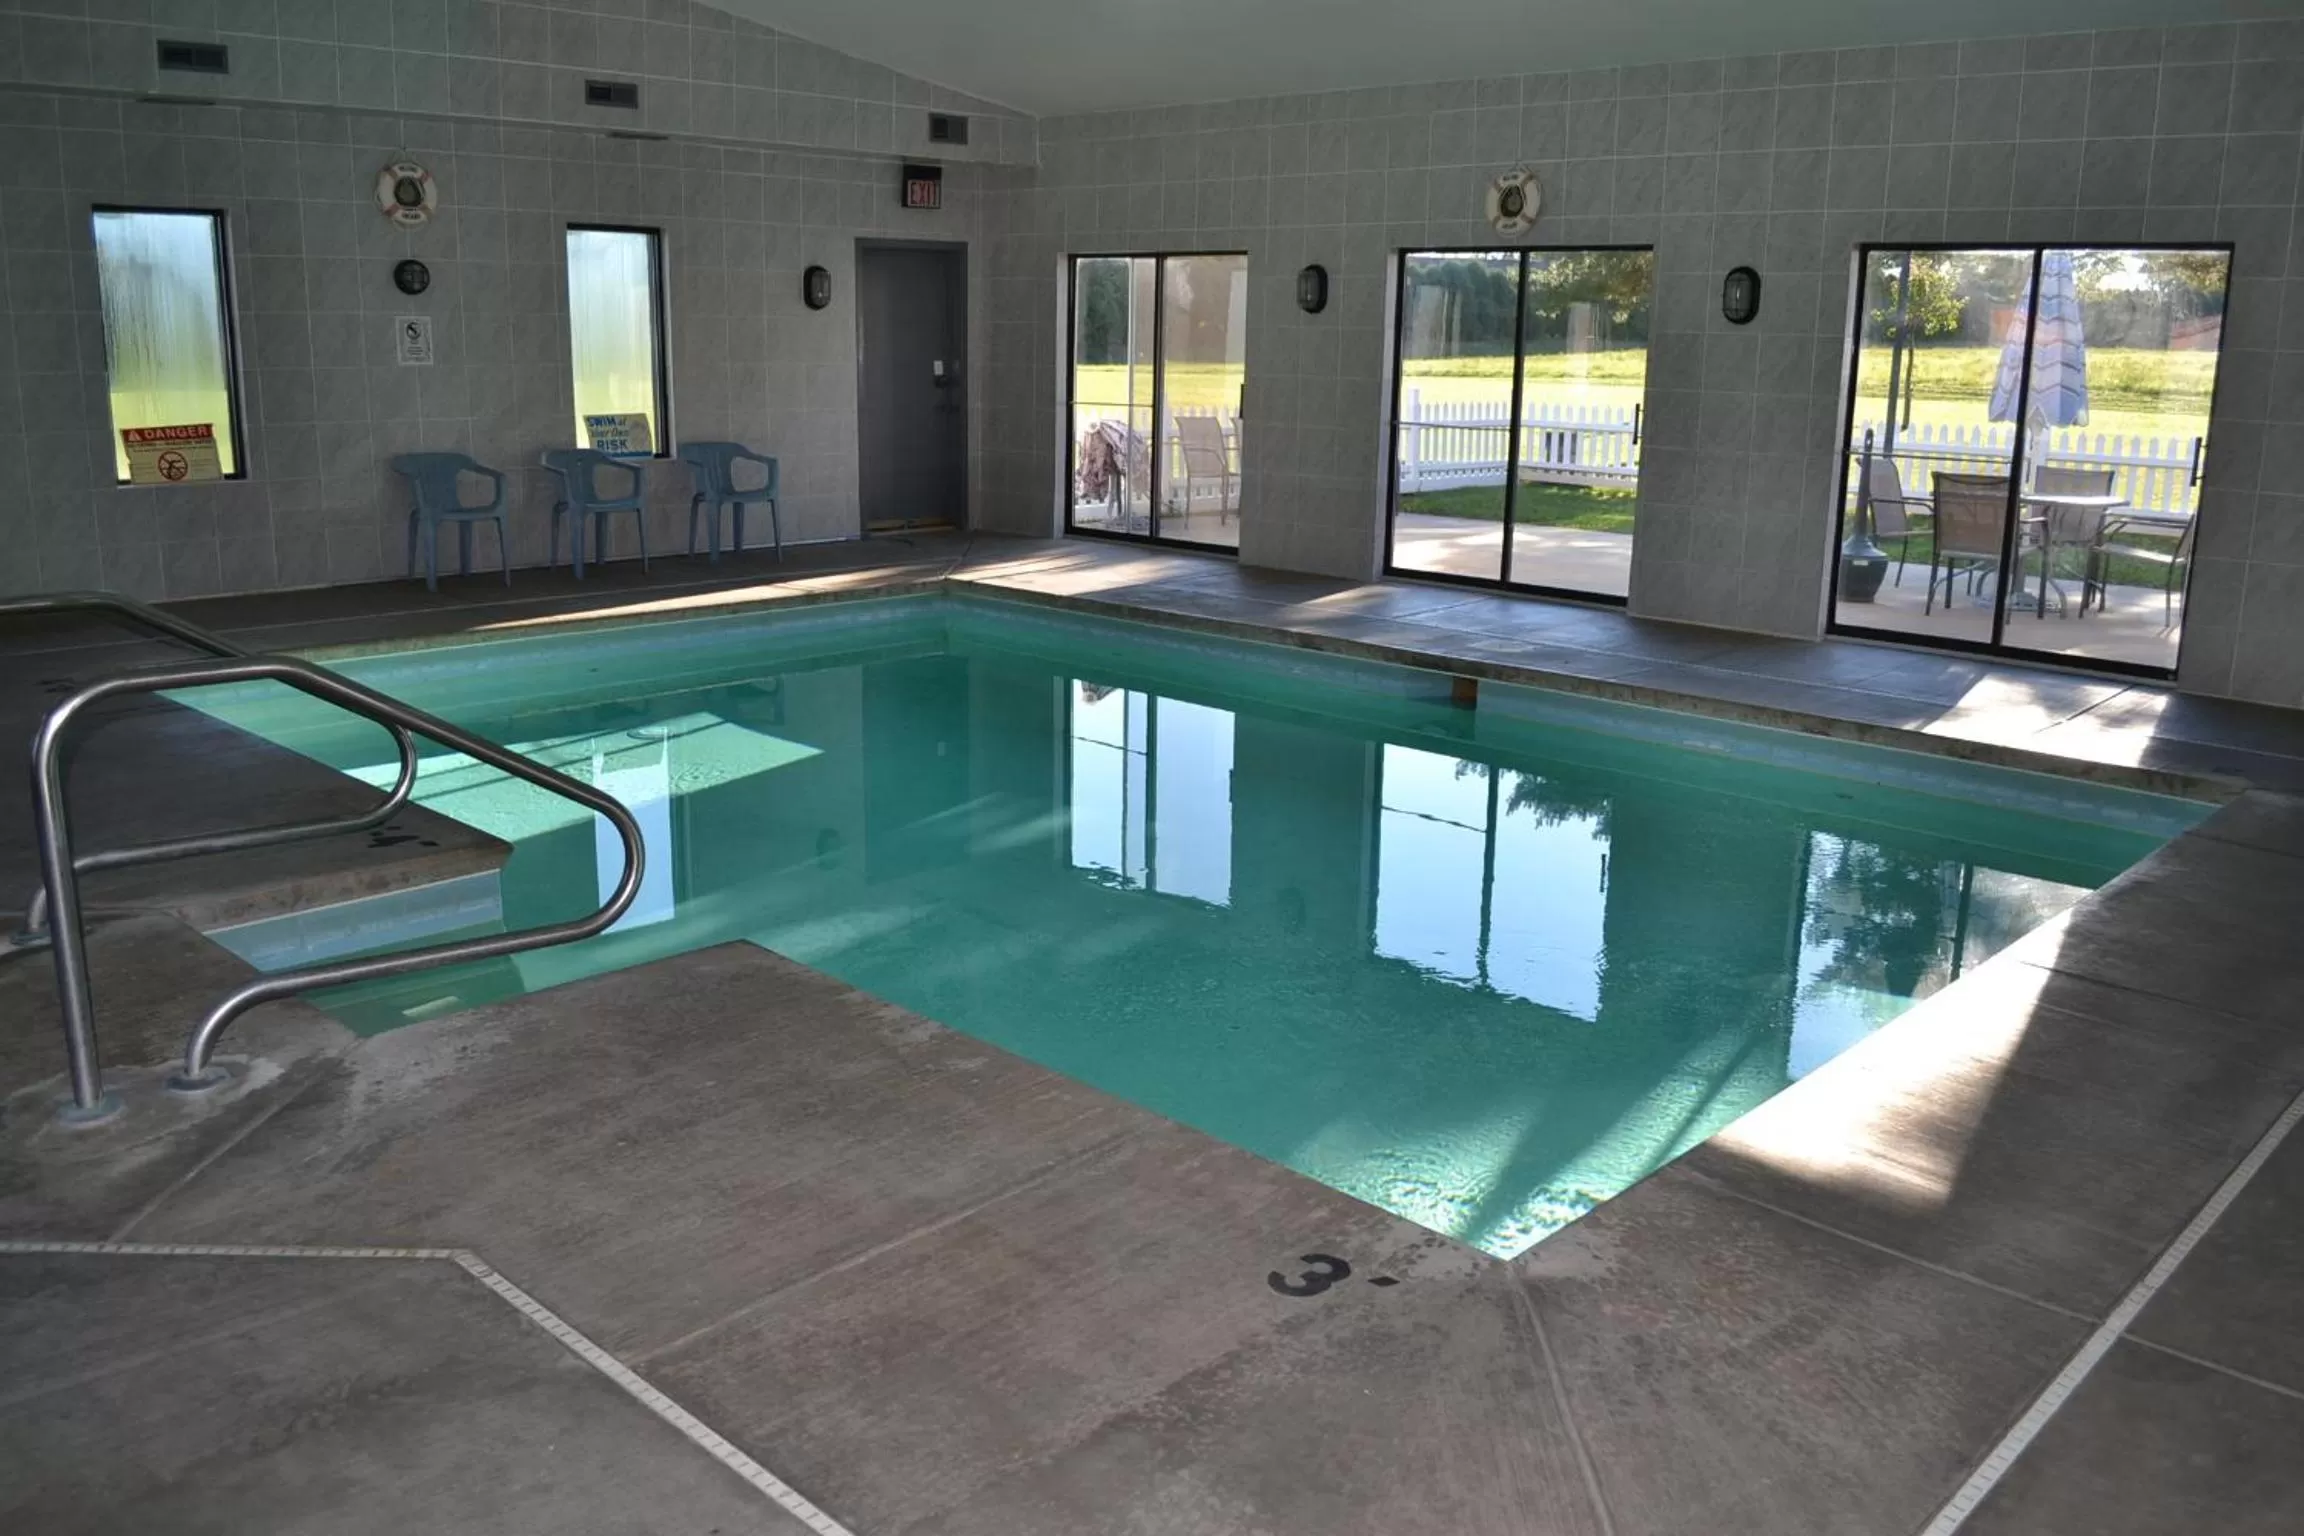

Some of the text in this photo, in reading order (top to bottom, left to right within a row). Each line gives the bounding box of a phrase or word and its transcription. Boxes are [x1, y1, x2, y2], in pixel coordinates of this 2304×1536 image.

[910, 181, 939, 206] EXIT
[587, 415, 616, 427] SWIM
[143, 426, 208, 439] DANGER
[596, 439, 629, 451] RISK
